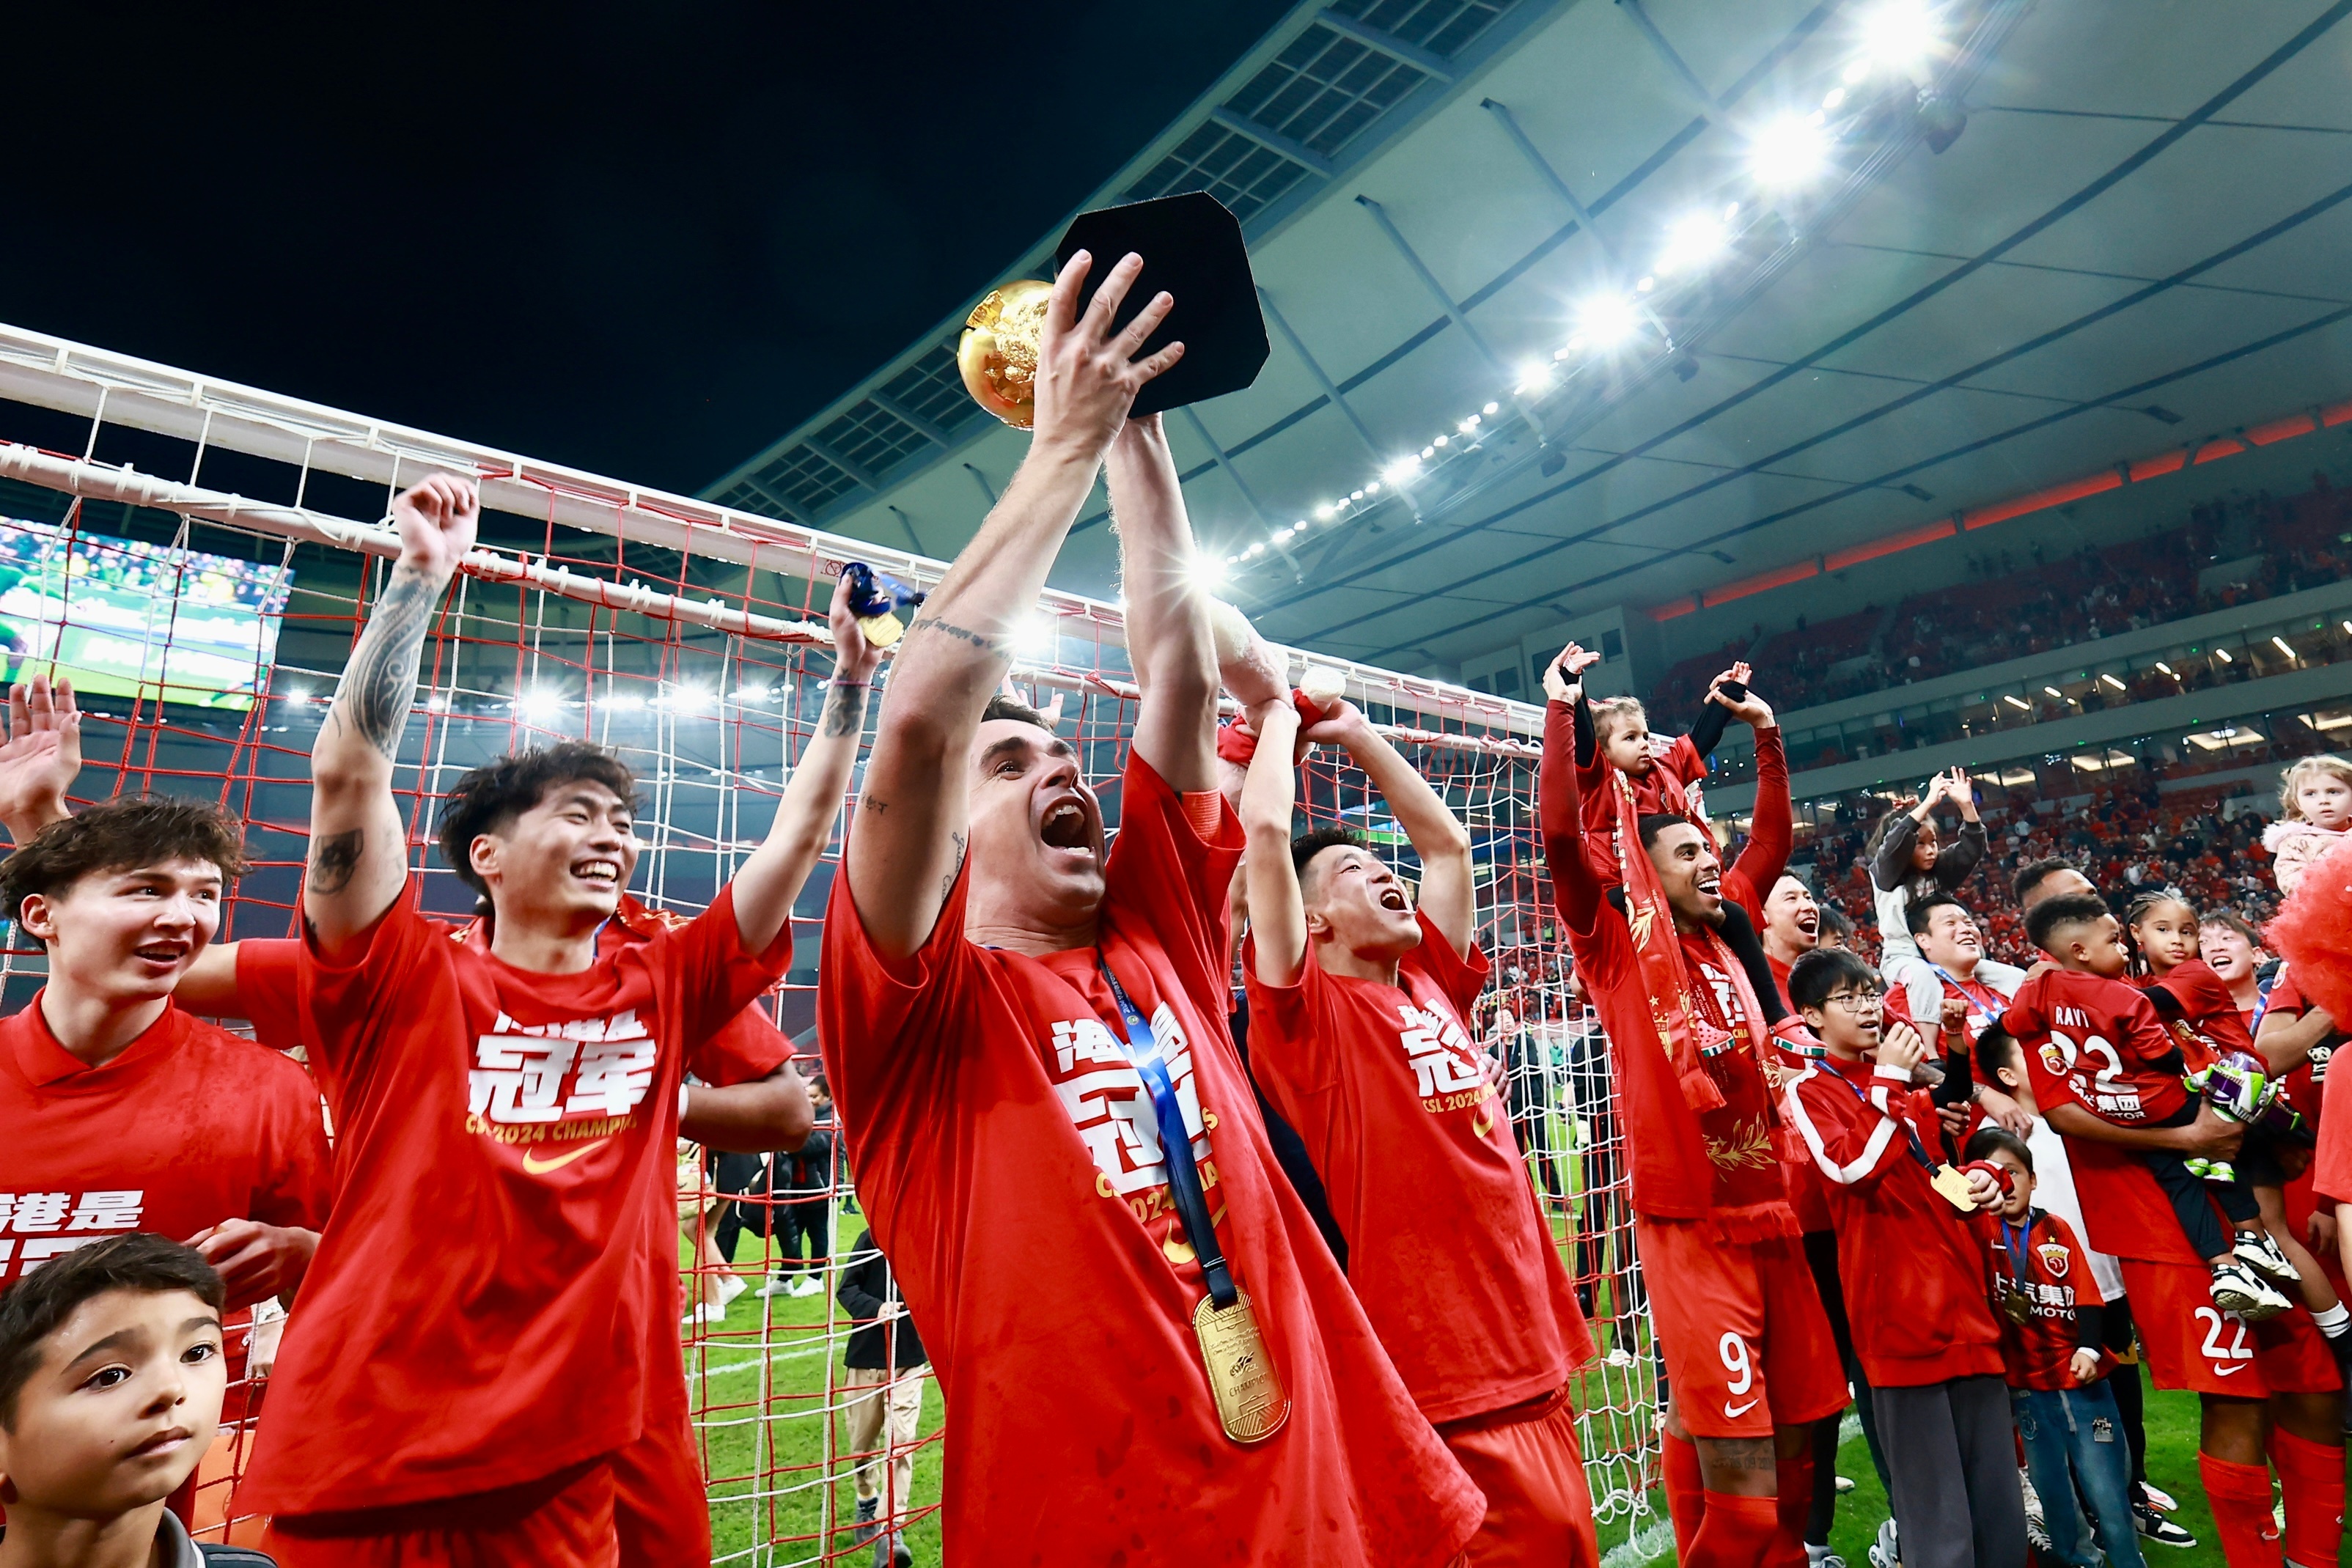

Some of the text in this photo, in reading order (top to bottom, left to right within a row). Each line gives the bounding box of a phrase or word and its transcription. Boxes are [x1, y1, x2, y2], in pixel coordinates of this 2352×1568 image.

[468, 1034, 657, 1123] 冠军
[1422, 1098, 1444, 1114] CSL
[1445, 1090, 1481, 1111] 2024
[492, 1123, 546, 1145] 2024
[1129, 1185, 1176, 1224] 024
[2194, 1306, 2254, 1359] 22
[1719, 1331, 1752, 1395] 9
[1229, 1372, 1267, 1397] CHAMPIO
